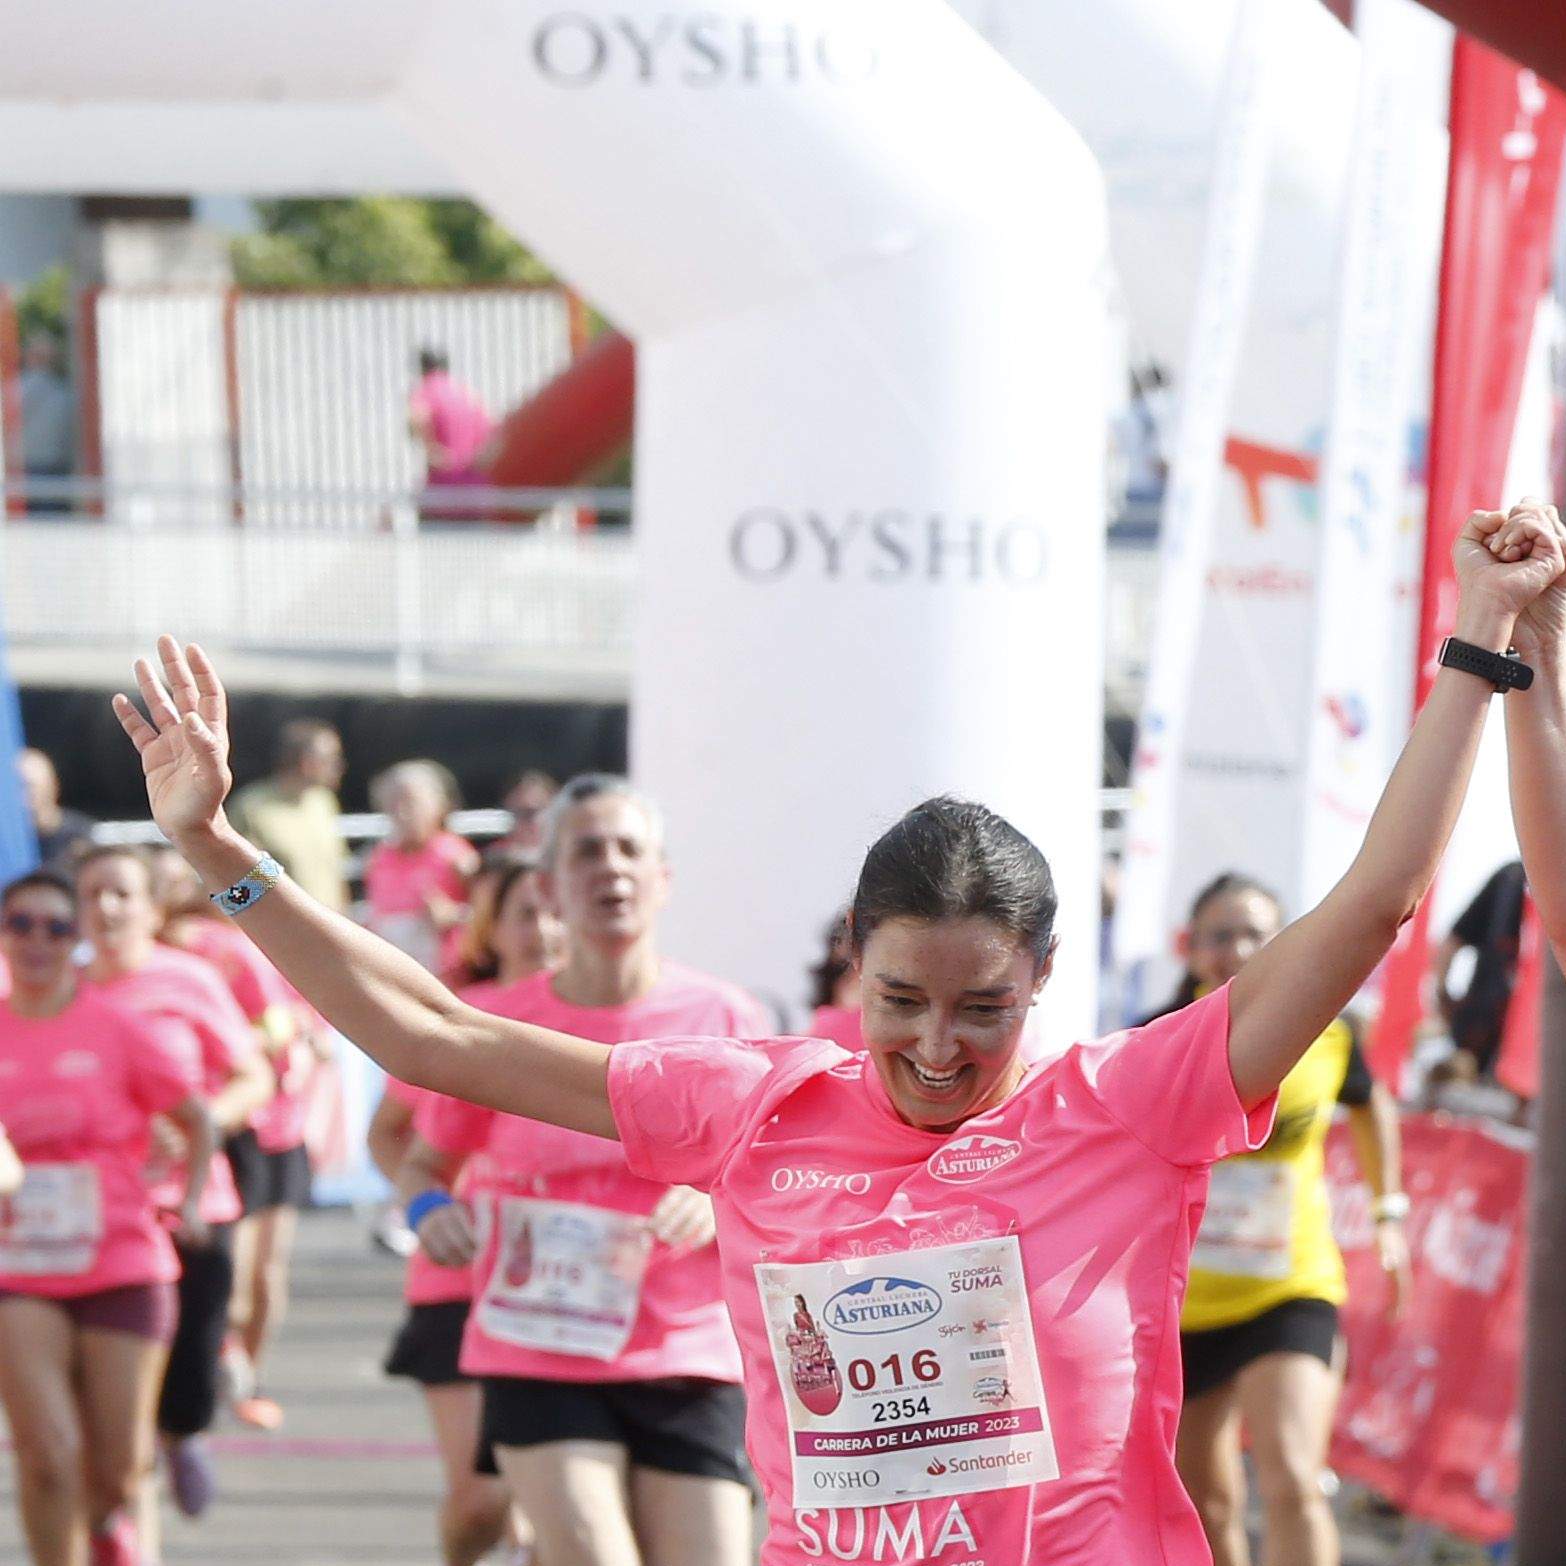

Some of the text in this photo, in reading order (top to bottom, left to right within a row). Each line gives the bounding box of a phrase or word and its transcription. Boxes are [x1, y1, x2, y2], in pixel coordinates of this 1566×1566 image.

[771, 1167, 872, 1195] OYSHO
[951, 1274, 1003, 1293] SUMA
[963, 1265, 1002, 1278] DORSAL
[833, 1298, 934, 1326] ASTURIANA
[848, 1349, 941, 1392] 016
[872, 1396, 931, 1422] 2354
[814, 1416, 1020, 1451] CARRERA DE LA MUJER 2023
[949, 1450, 1032, 1474] Santander
[813, 1469, 880, 1489] OYSHO
[794, 1500, 978, 1562] SUMA
